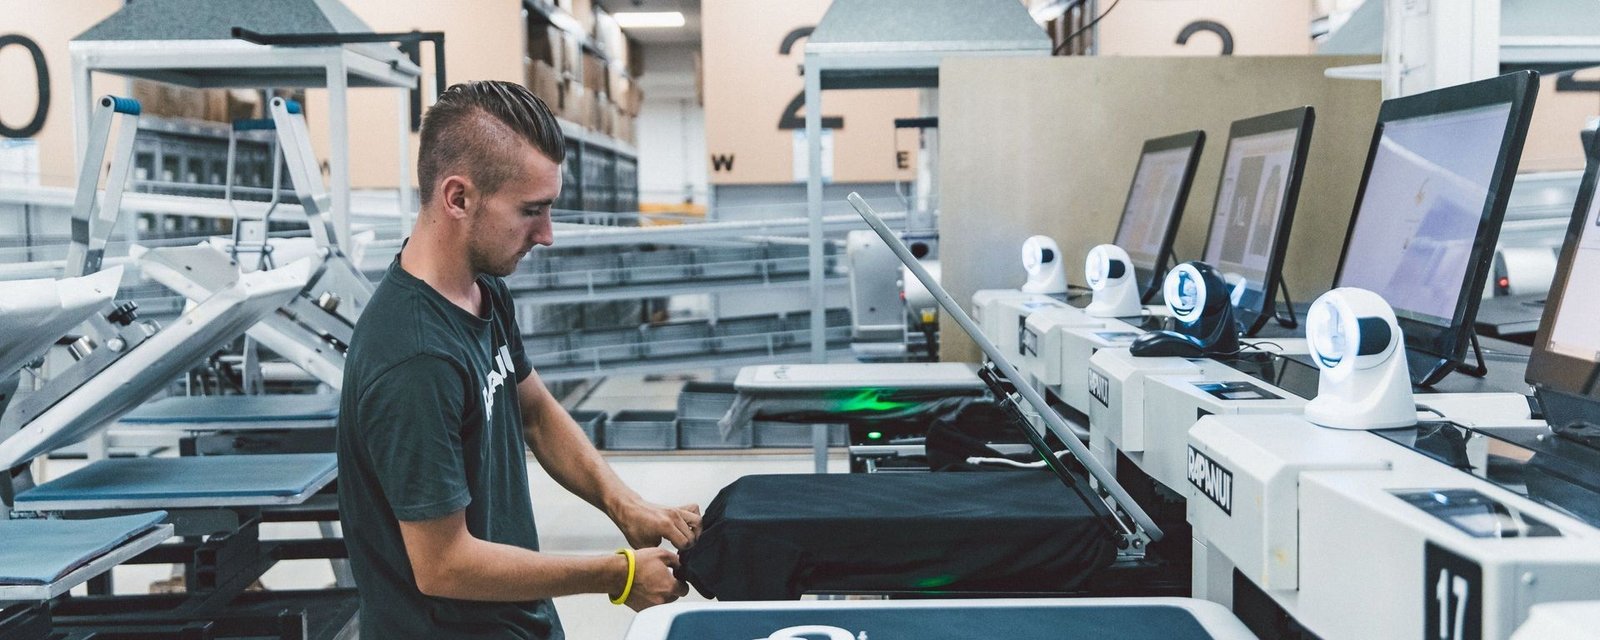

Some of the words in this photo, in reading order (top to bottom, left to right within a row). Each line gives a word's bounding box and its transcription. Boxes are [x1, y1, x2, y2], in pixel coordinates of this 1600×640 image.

[711, 154, 734, 171] W
[896, 151, 910, 169] E
[1188, 446, 1231, 511] RAPANUI
[1435, 568, 1469, 640] 17
